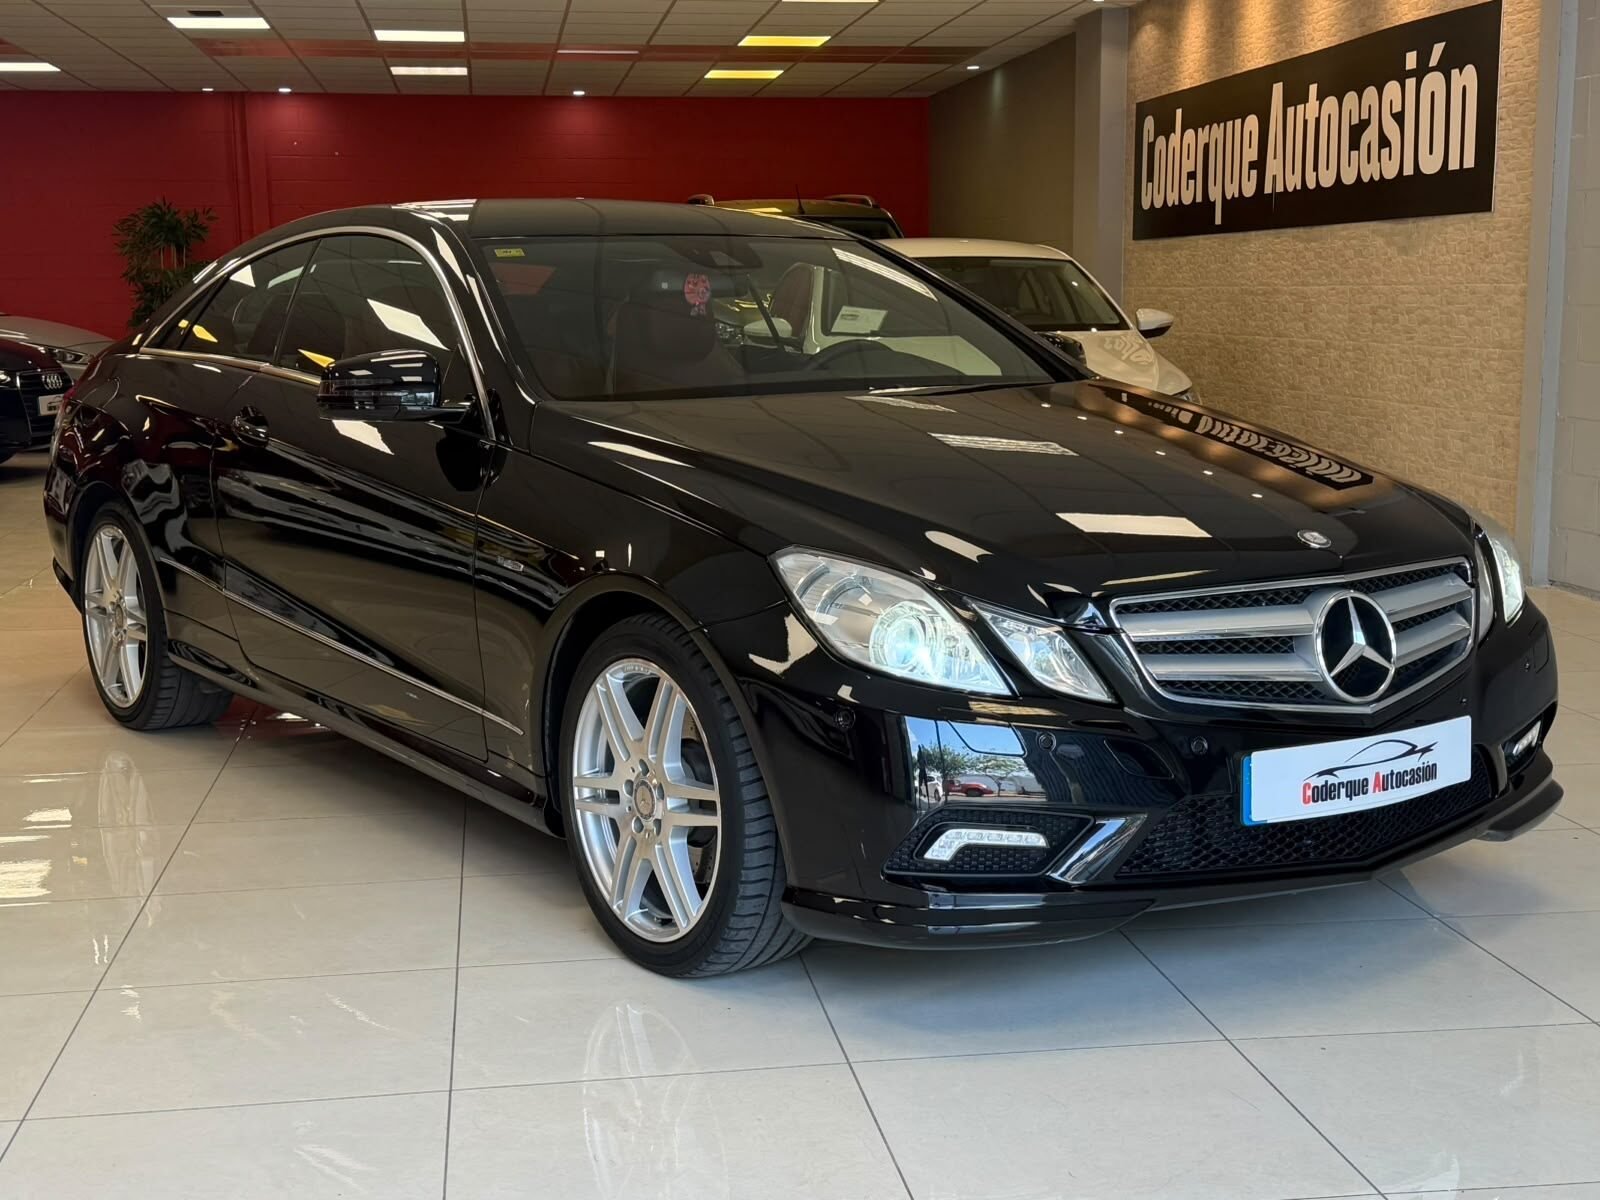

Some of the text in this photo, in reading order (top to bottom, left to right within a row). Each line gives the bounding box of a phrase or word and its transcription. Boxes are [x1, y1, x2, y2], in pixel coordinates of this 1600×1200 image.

[1141, 41, 1478, 225] Coderque Autocasión
[1302, 761, 1438, 805] Coderque Autocasión
